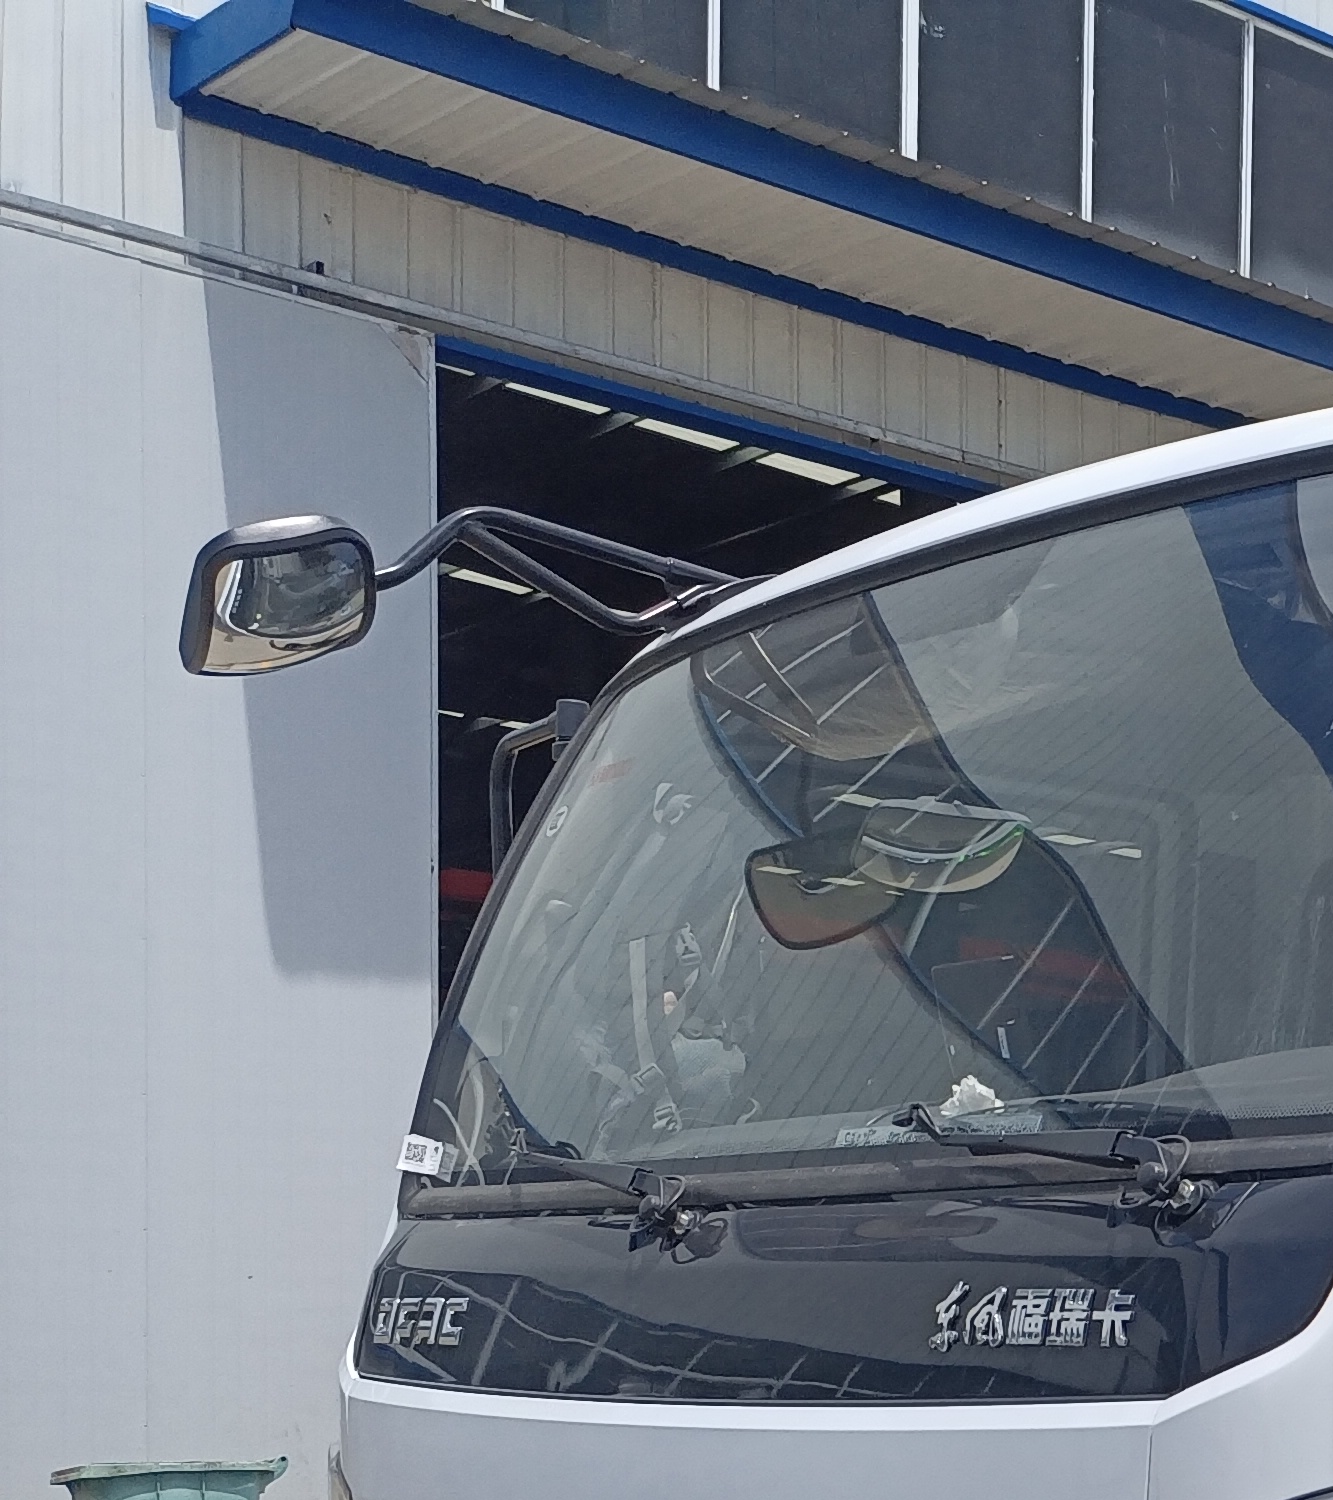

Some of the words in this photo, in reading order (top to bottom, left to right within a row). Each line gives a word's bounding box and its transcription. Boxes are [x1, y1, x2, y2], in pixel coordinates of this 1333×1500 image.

[374, 1297, 470, 1346] DFAC
[928, 1280, 1136, 1353] 东风福瑞卡
